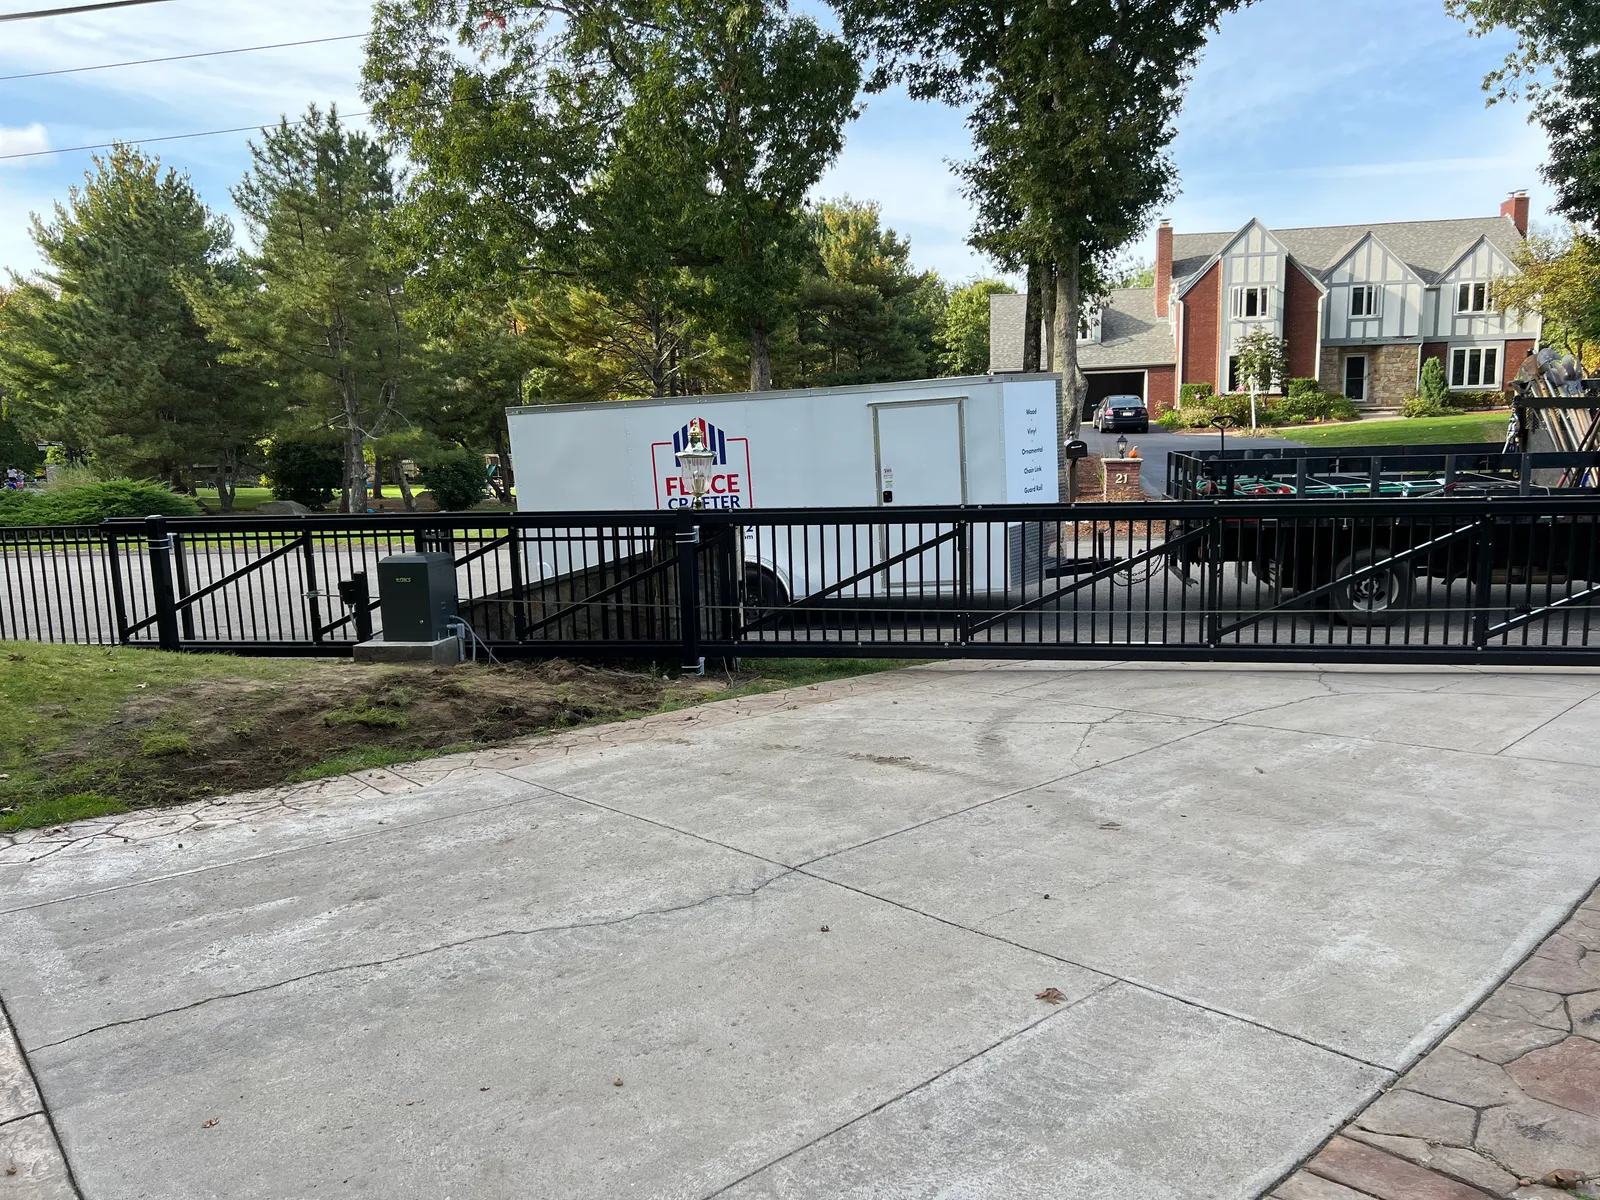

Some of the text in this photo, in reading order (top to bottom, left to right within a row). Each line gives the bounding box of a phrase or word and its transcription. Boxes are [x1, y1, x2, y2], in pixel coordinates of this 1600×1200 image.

[1027, 427, 1037, 435] Vinyl
[1021, 446, 1043, 455] Ornamental
[1115, 473, 1128, 484] 21
[665, 474, 740, 496] FECE
[667, 495, 741, 510] CRFTER
